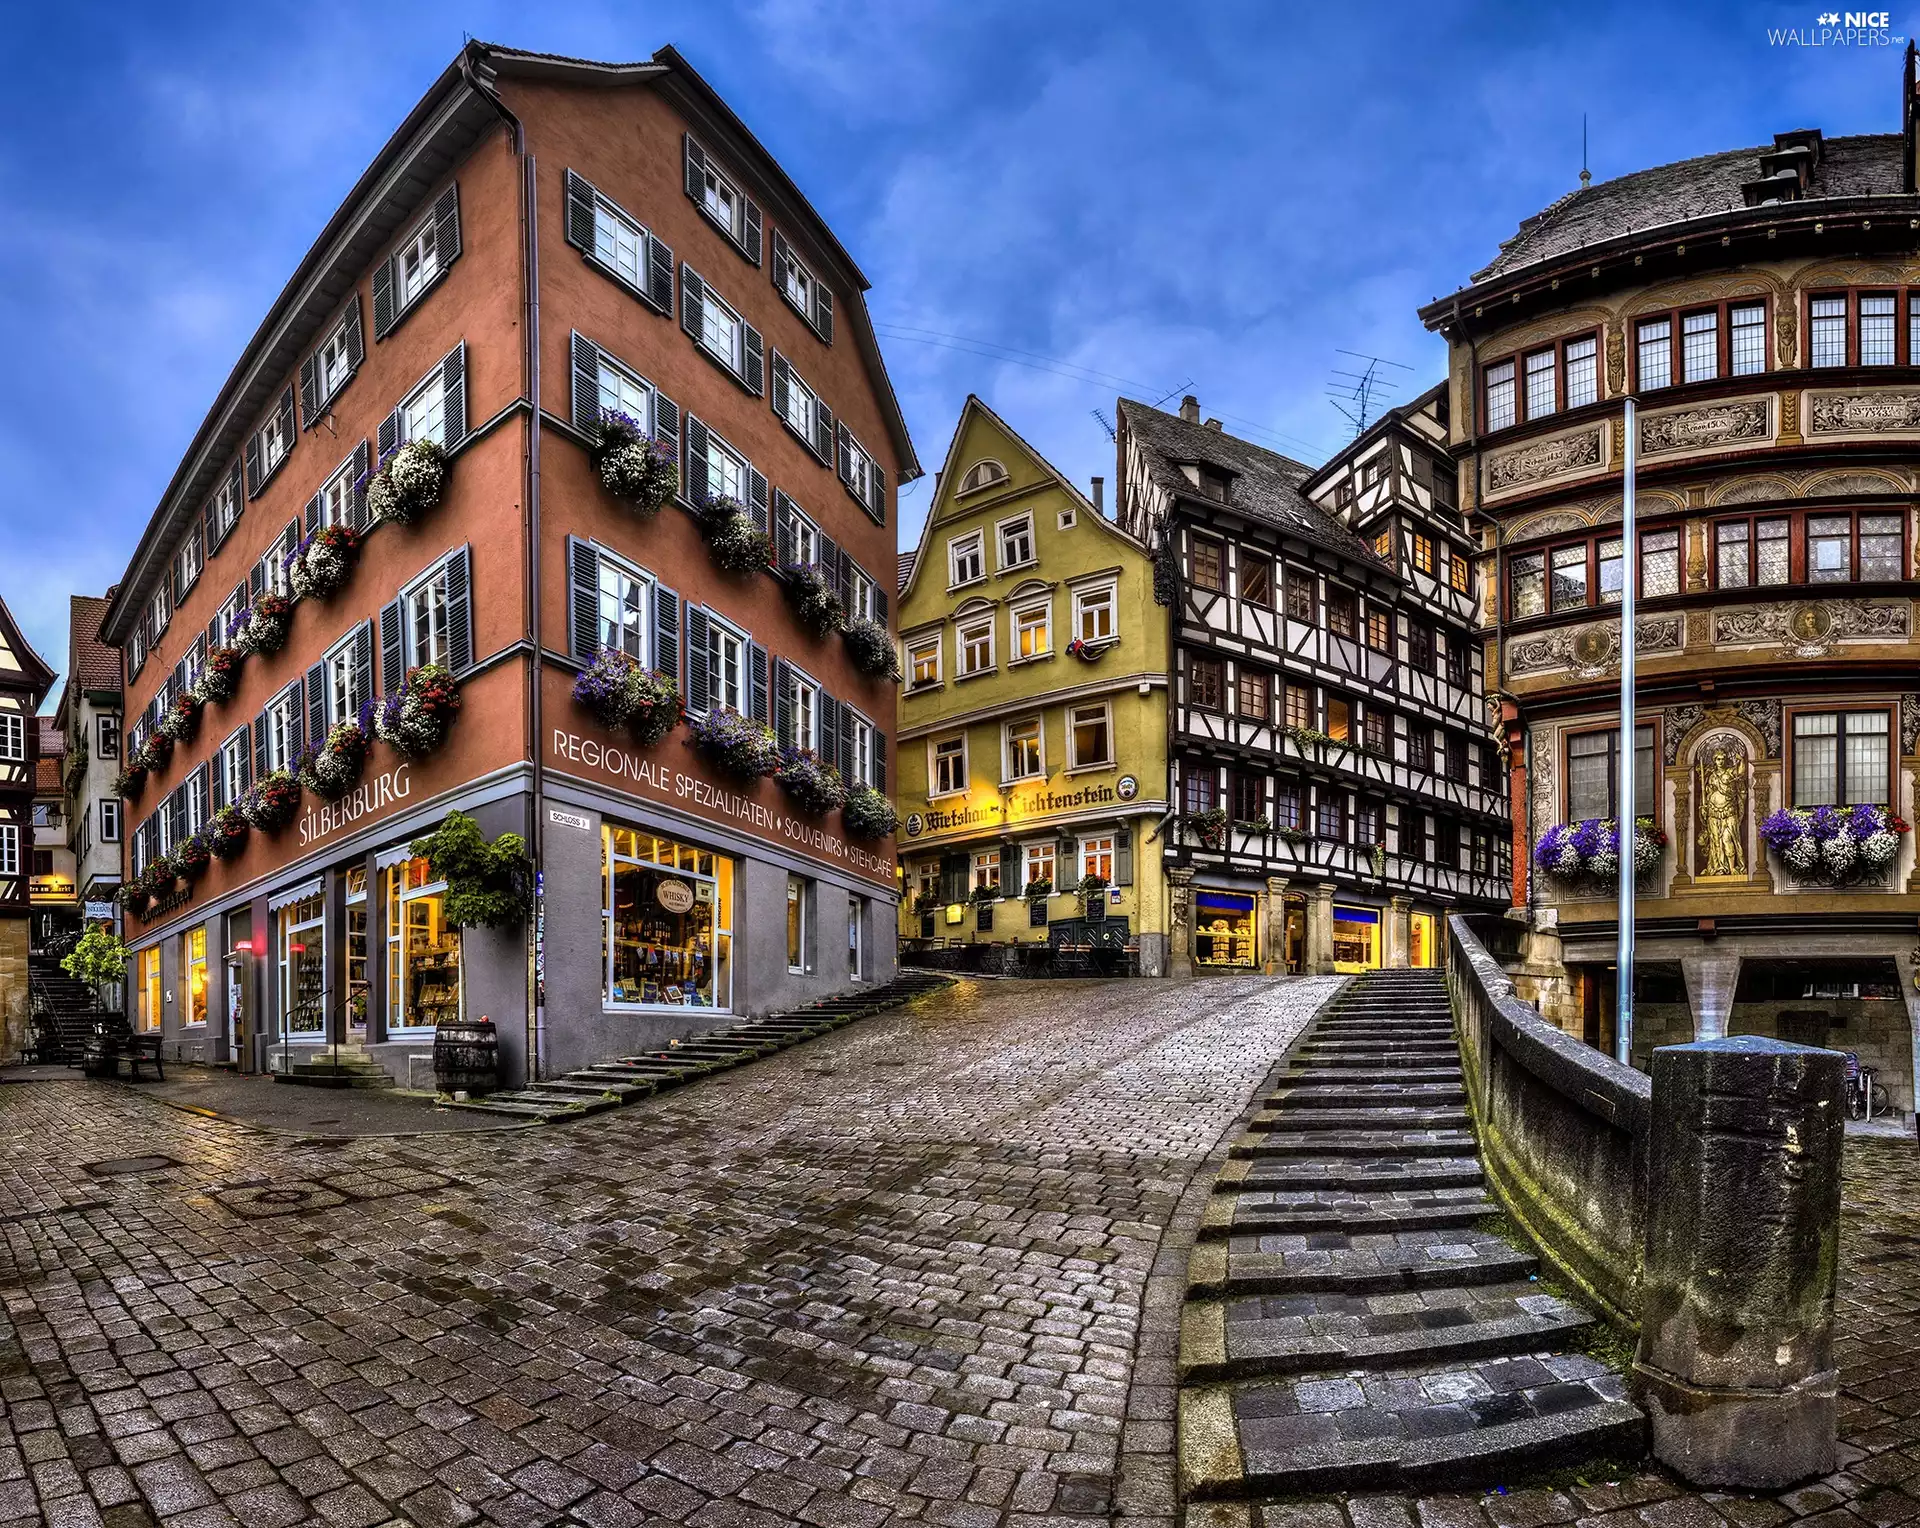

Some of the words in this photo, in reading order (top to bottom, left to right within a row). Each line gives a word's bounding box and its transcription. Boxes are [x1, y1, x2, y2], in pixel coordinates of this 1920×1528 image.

[299, 763, 410, 847] SILBERBURG
[552, 812, 581, 826] SCHLOSS
[554, 729, 670, 792] REGIONALE
[675, 773, 773, 831] SPEZIALITÄTEN
[785, 817, 842, 857] SOUVENIRS
[850, 844, 892, 879] STEHCAFÉ
[662, 890, 690, 903] WHISKY
